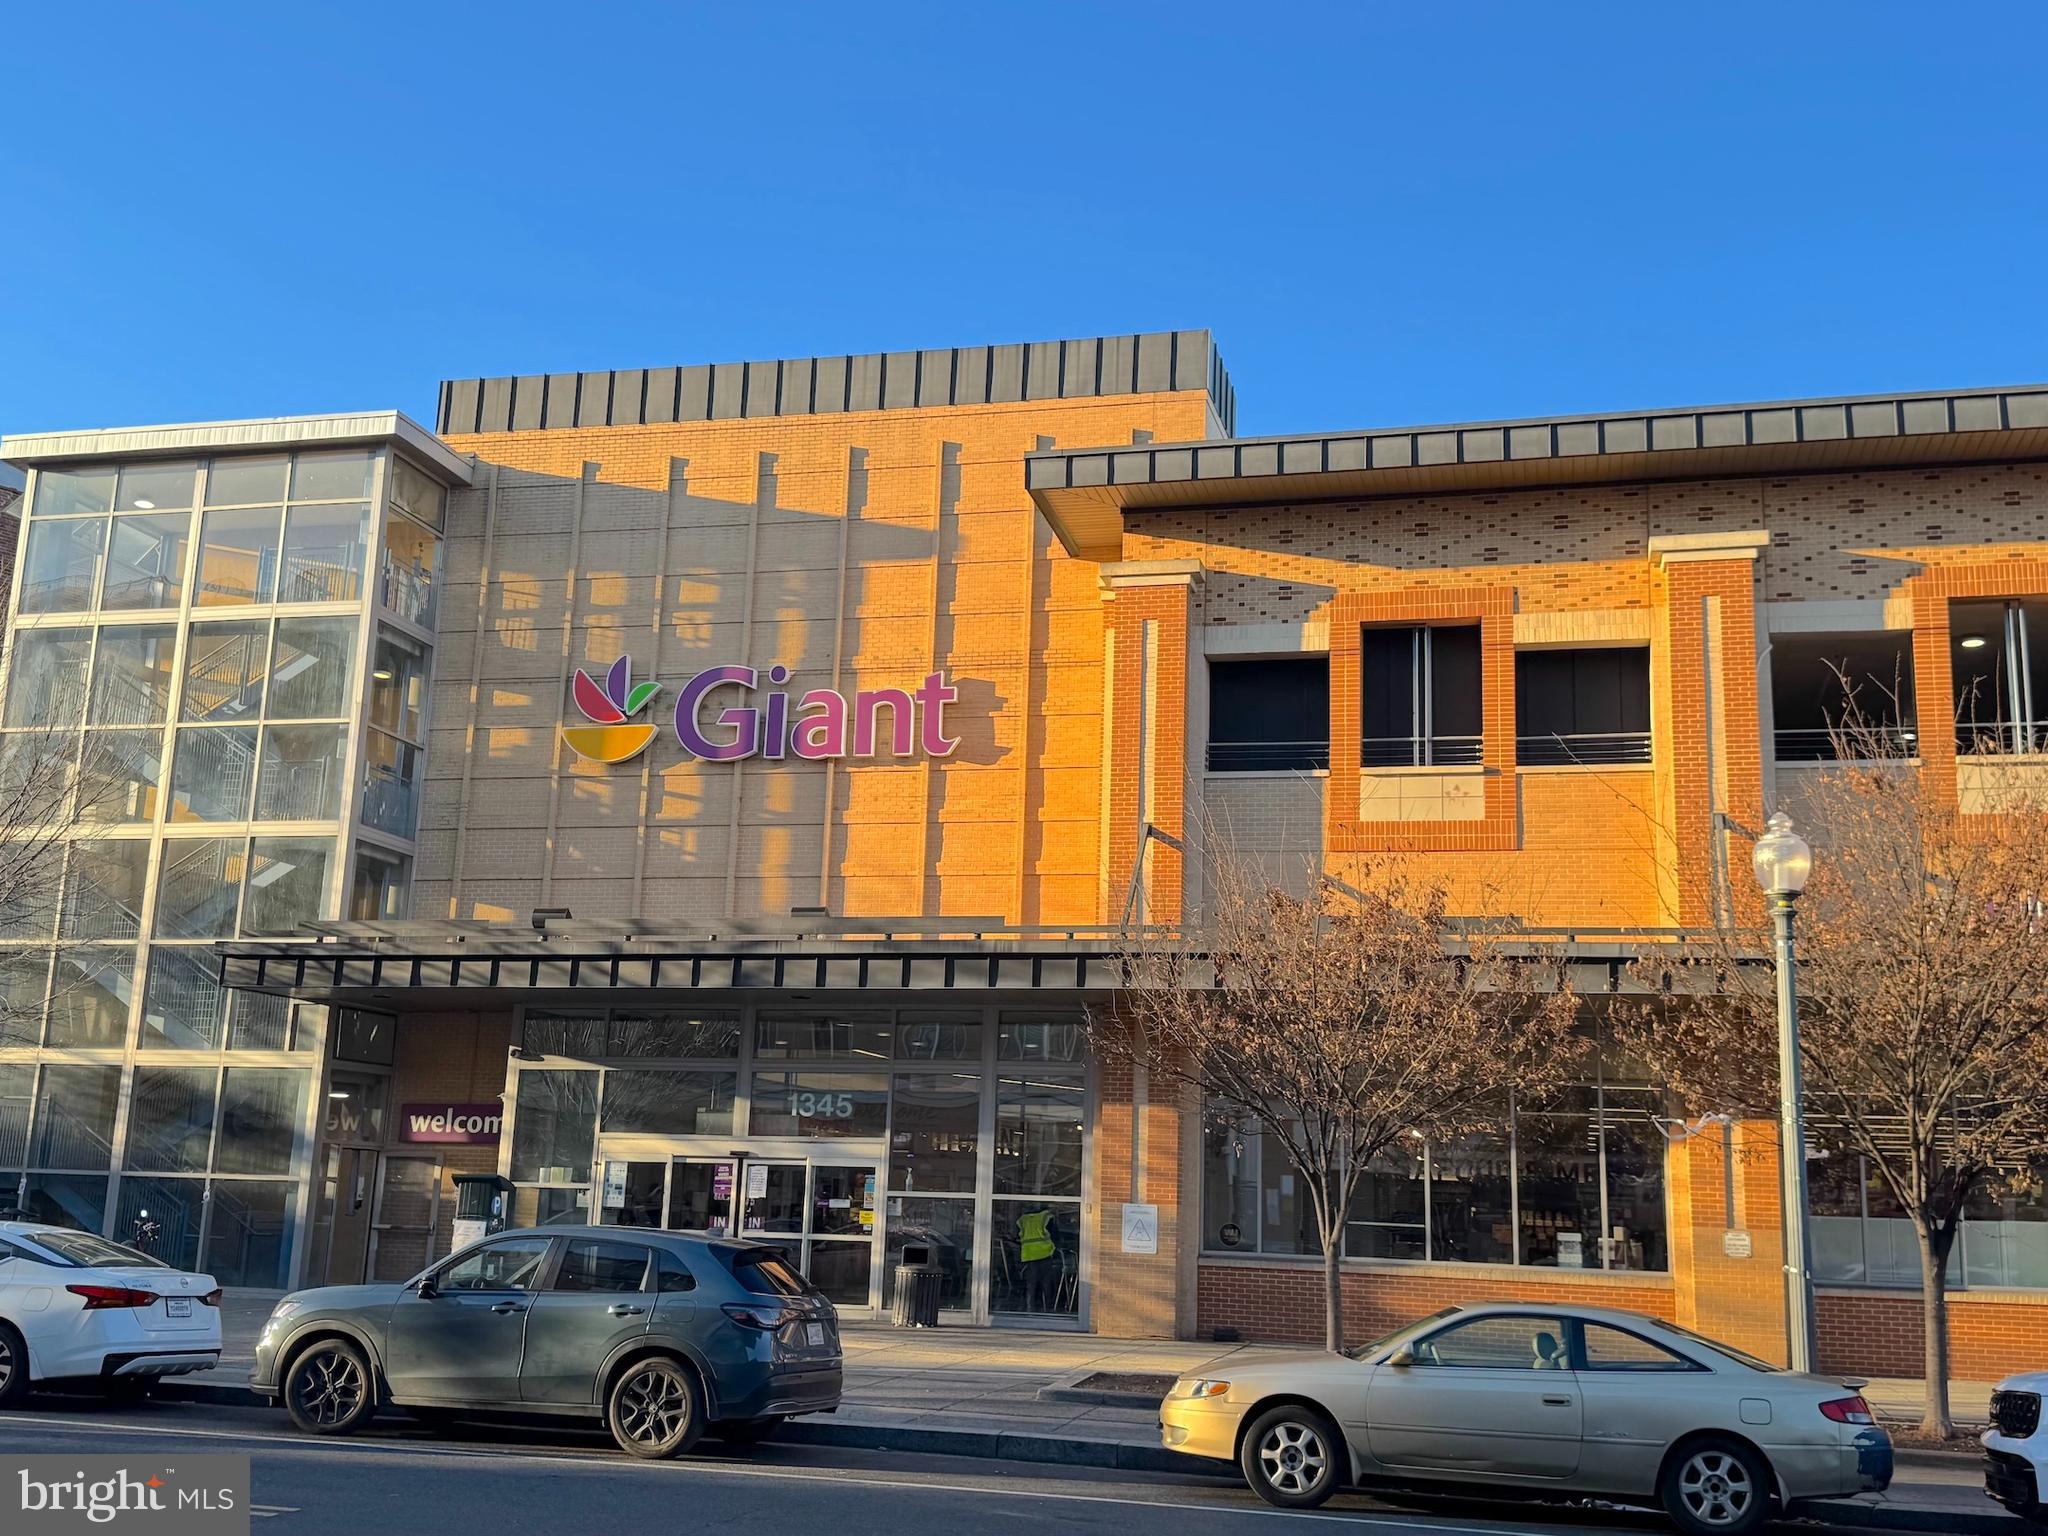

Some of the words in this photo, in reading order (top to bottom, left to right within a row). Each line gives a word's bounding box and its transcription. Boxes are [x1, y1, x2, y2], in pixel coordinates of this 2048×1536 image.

[674, 665, 961, 762] Giant
[787, 1093, 852, 1118] 1345
[410, 1108, 503, 1133] welcom
[713, 1216, 728, 1228] IN
[748, 1217, 761, 1229] IN
